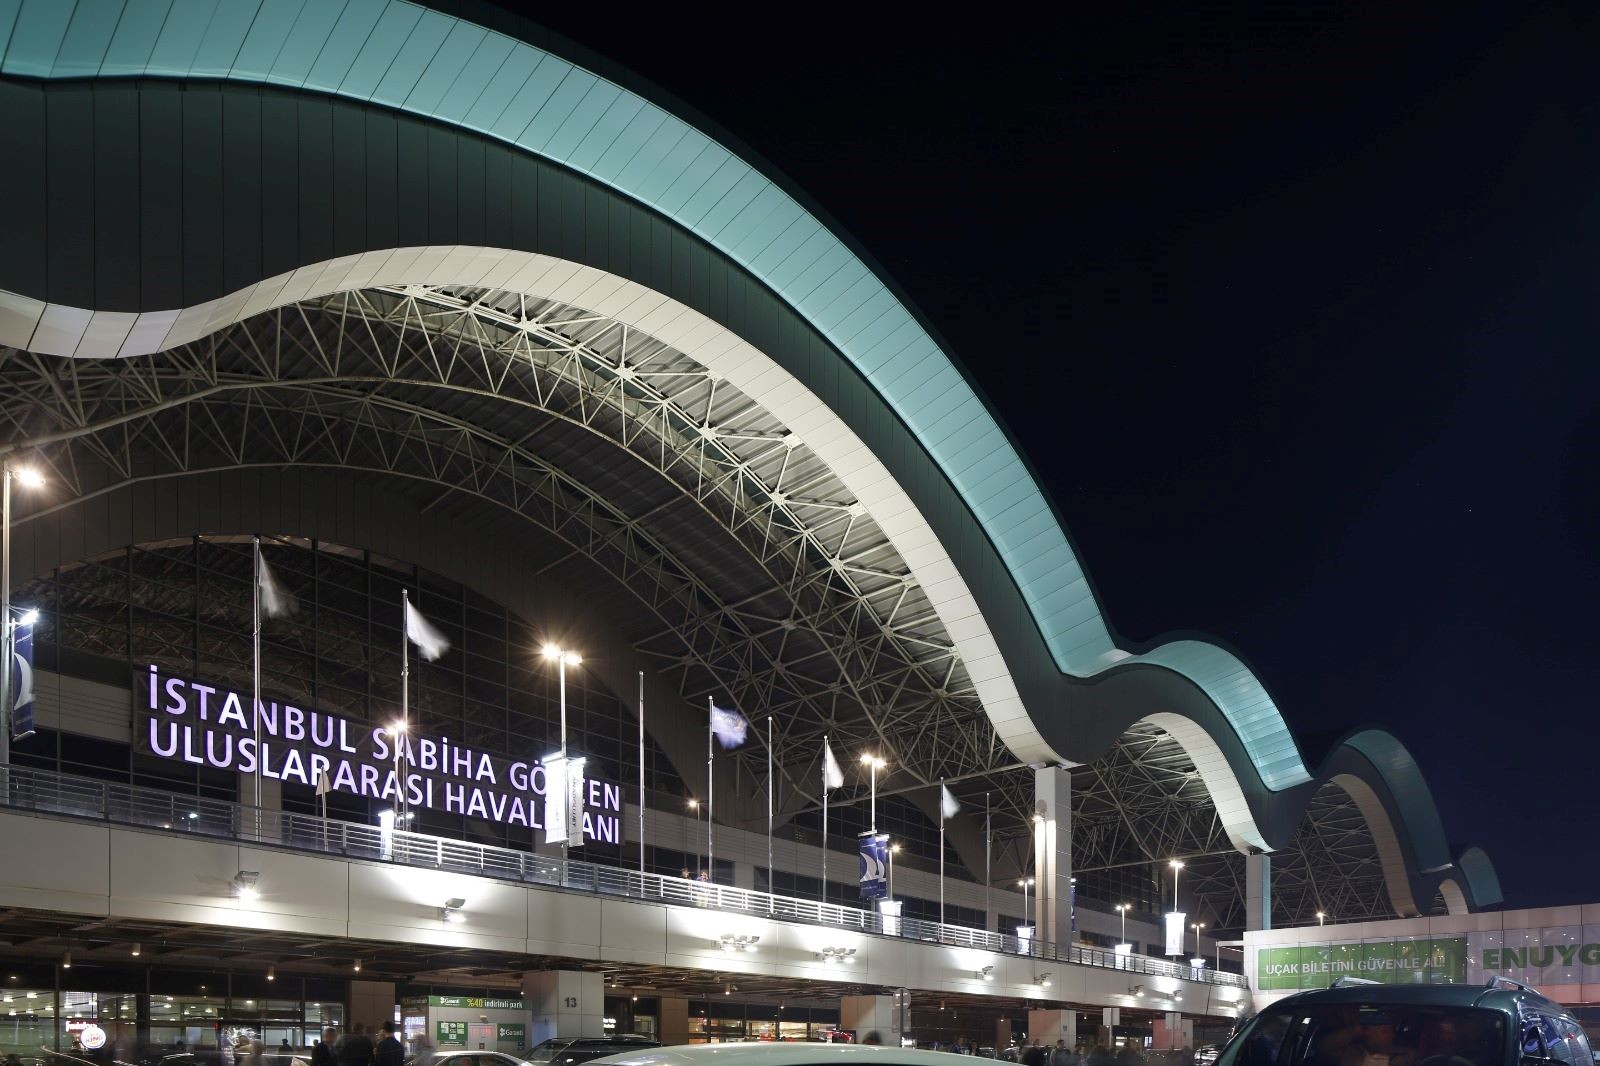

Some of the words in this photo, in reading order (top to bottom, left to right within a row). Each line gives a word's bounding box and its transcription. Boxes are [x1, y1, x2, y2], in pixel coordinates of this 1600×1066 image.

[150, 664, 356, 753] İSTANBUL
[372, 728, 497, 784] SABİHA
[510, 759, 620, 812] GÖEN
[150, 718, 433, 808] ULUSLARARASI
[446, 782, 620, 845] HAVALANI
[1265, 963, 1298, 976] UÇAK
[1302, 959, 1354, 974] BİLETİNİ
[1358, 956, 1420, 971] GÜVENLE
[466, 998, 483, 1008] %40
[564, 996, 577, 1008] 13
